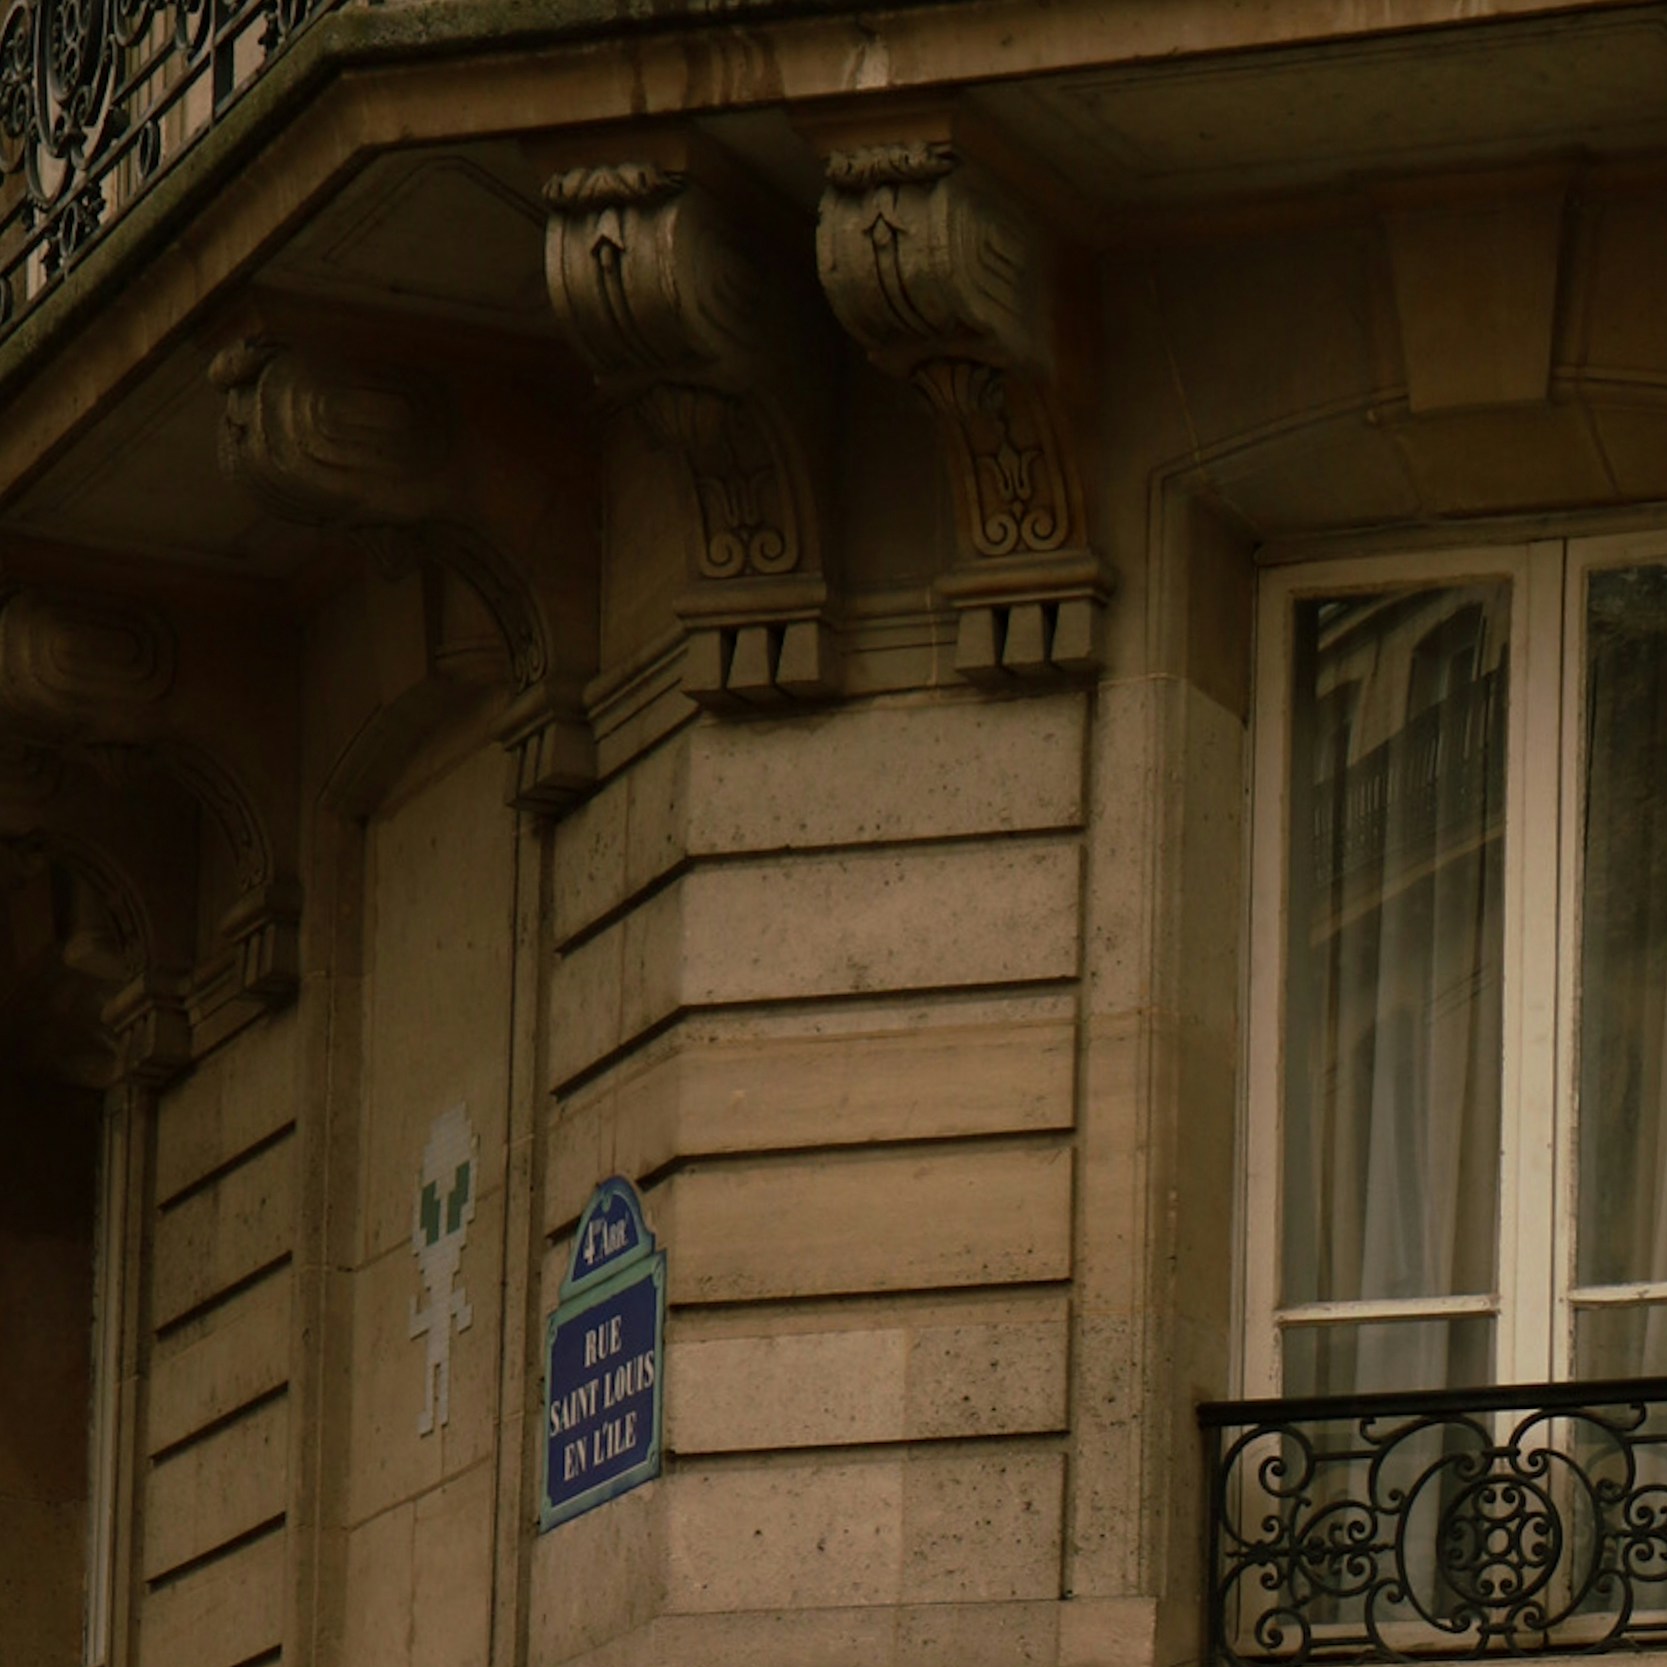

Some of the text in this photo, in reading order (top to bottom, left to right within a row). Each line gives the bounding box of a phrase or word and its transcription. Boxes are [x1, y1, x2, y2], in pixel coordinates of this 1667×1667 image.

[584, 1315, 622, 1368] RUE
[550, 1350, 655, 1437] SAINT LOUIS
[563, 1436, 589, 1482] EN
